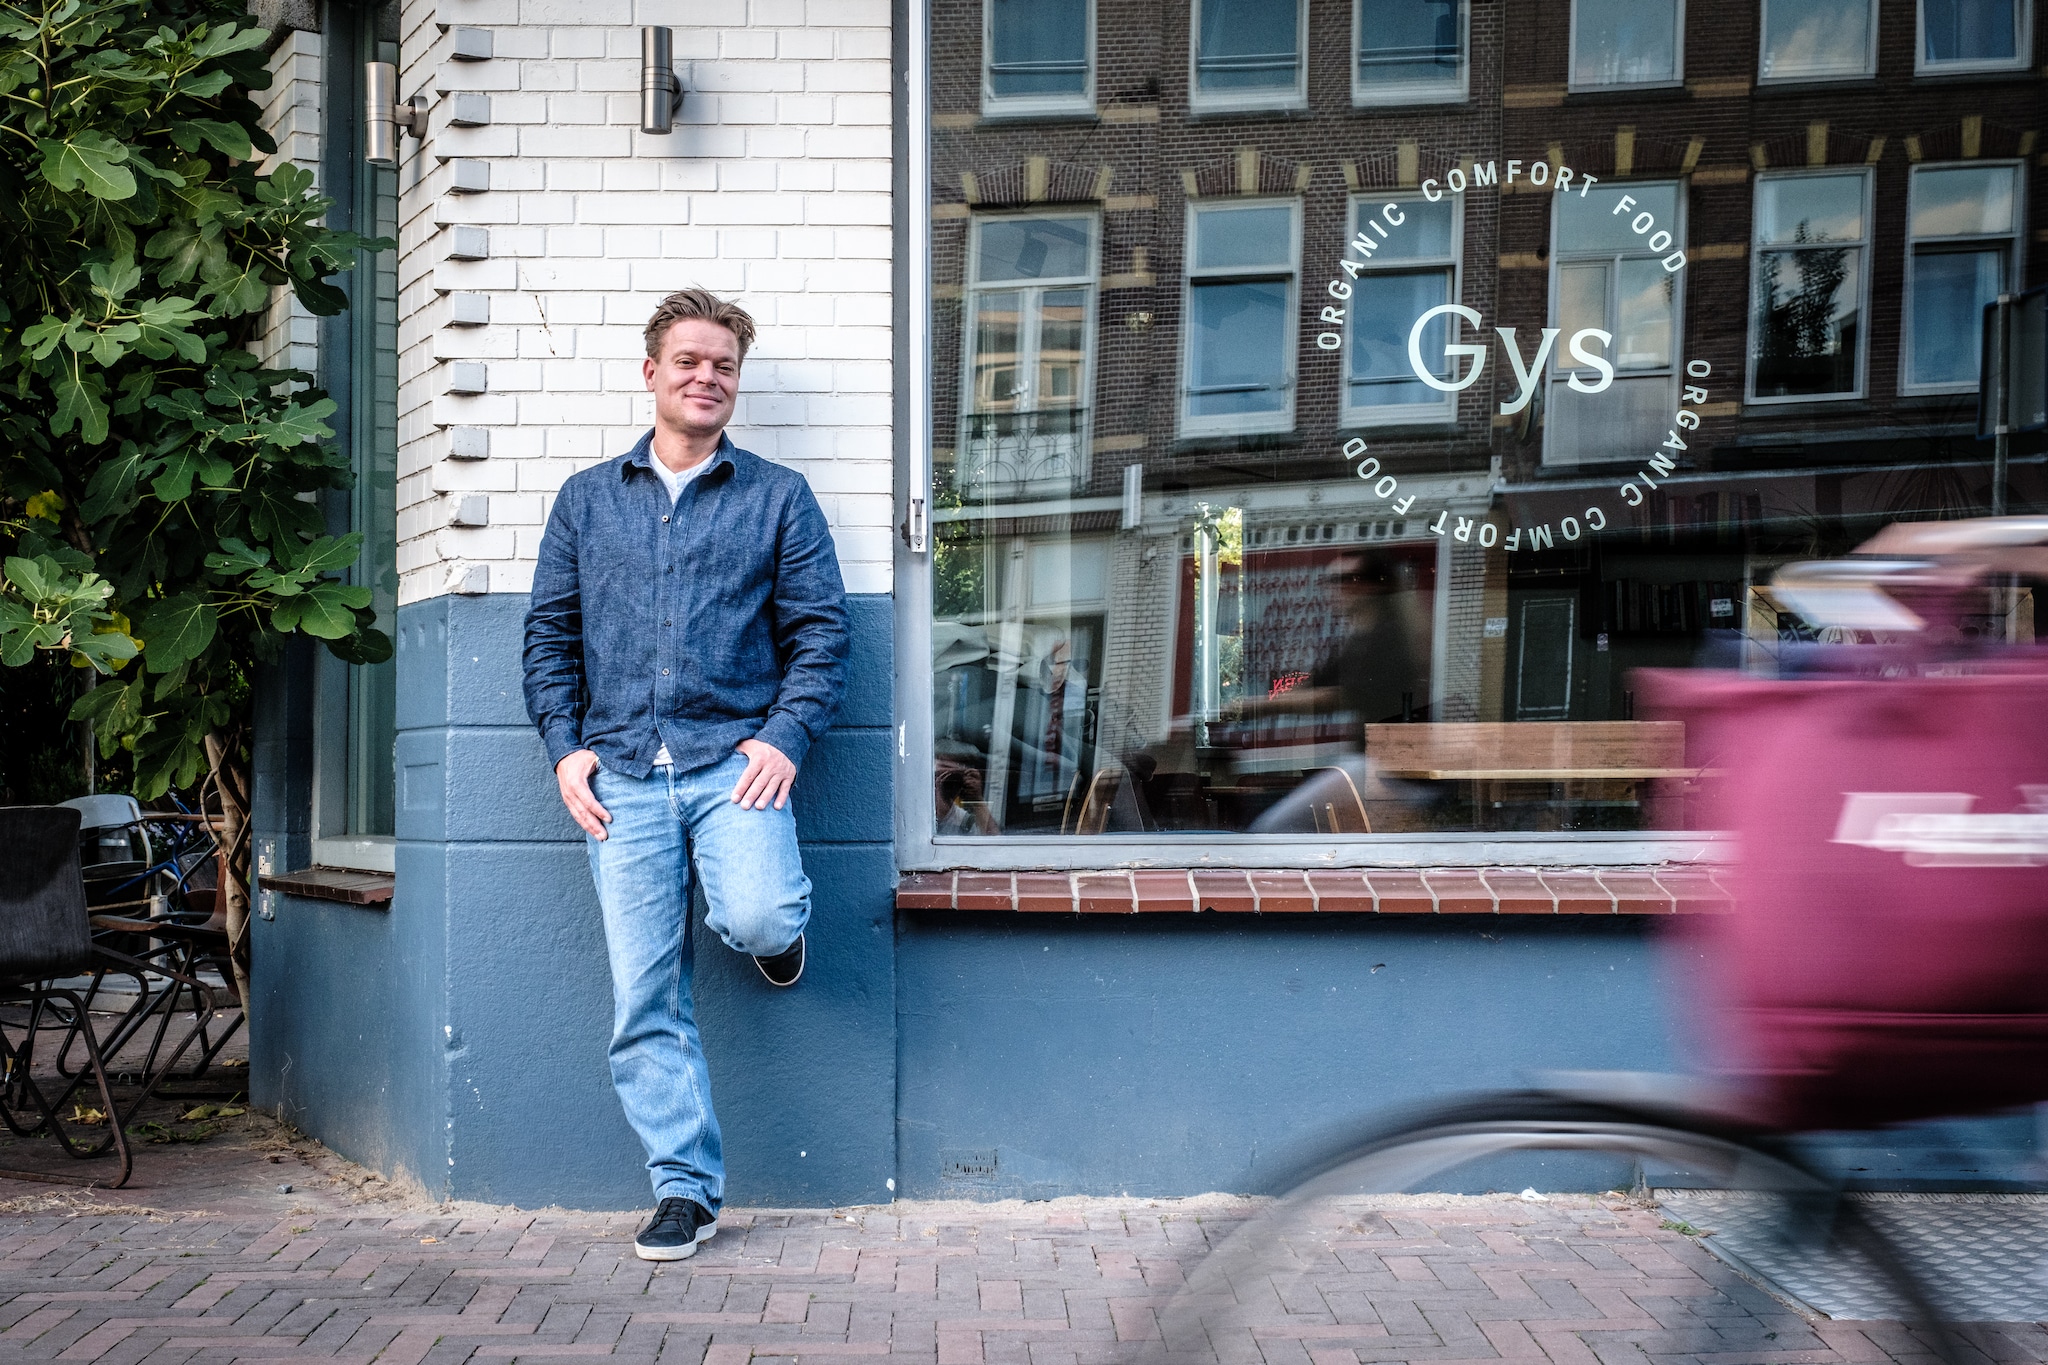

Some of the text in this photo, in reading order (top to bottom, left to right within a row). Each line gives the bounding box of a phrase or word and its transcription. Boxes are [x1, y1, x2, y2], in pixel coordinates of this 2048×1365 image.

[1317, 159, 1687, 350] ORGANIC COMFORT FOOD
[1342, 359, 1711, 552] ORGANIC COMFORT FOOD
[1408, 304, 1615, 416] Gys
